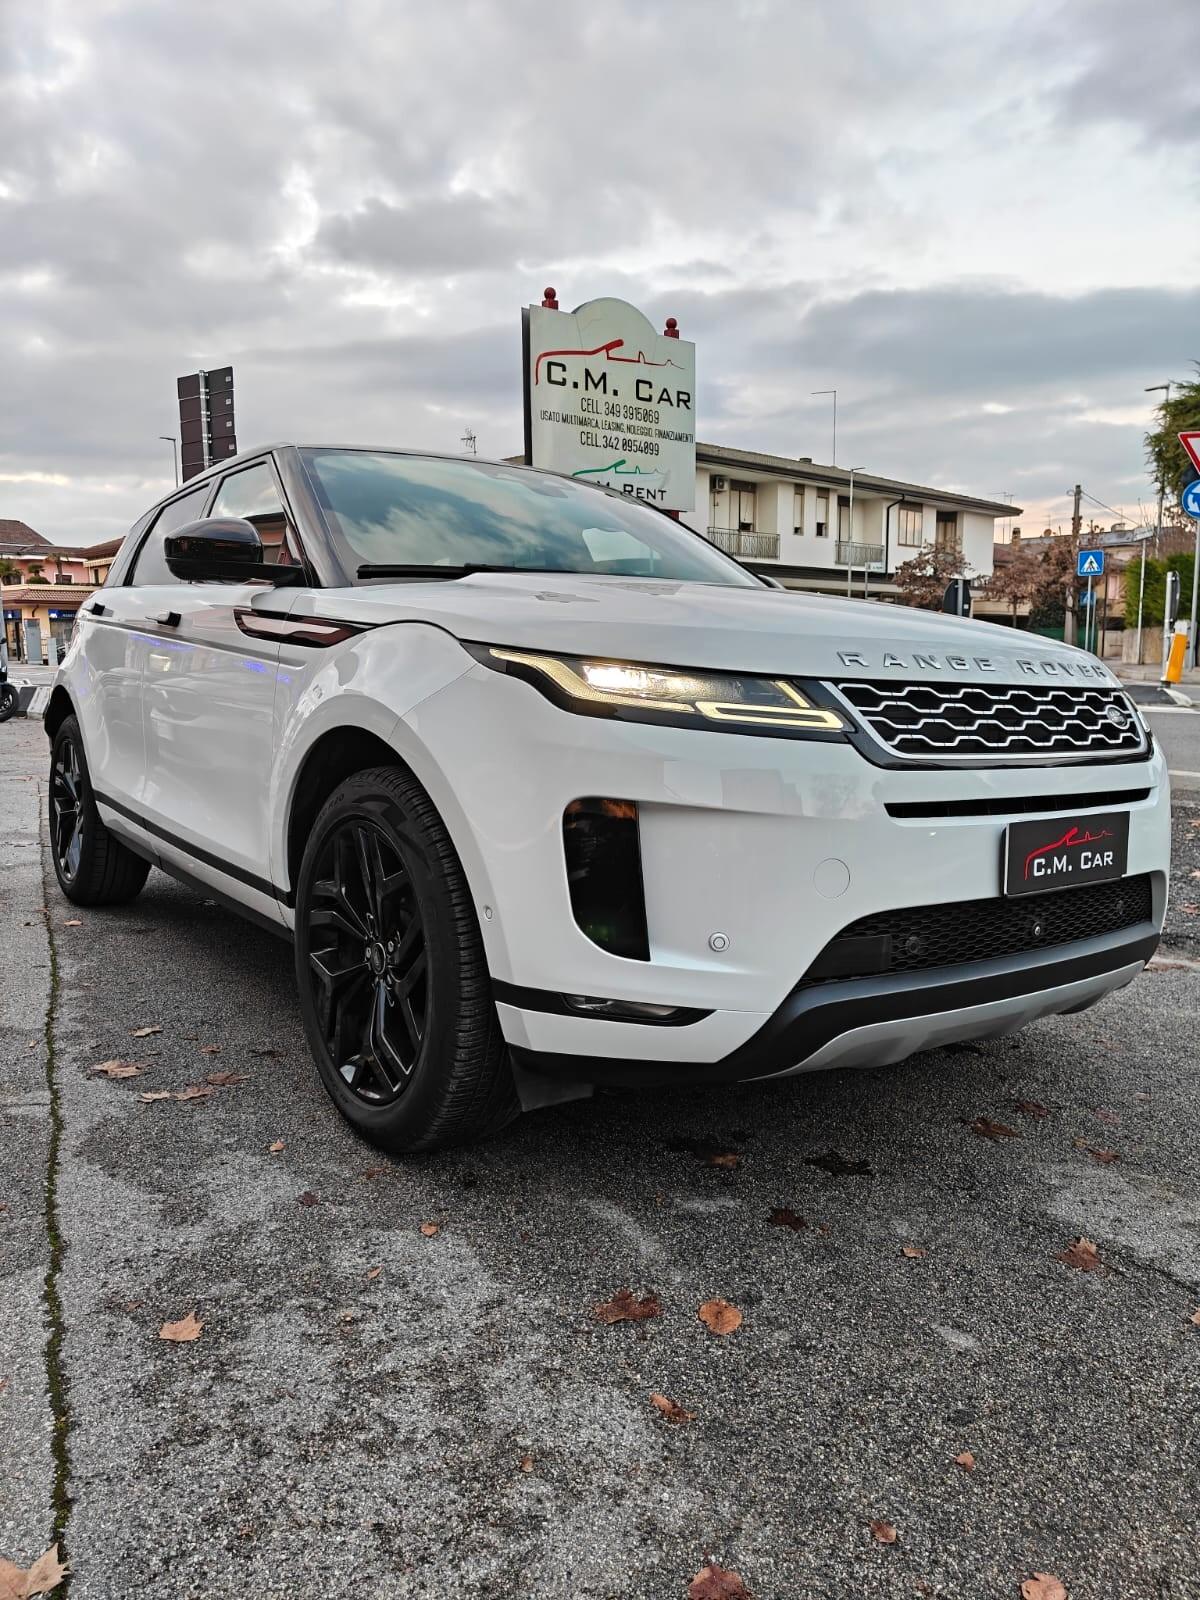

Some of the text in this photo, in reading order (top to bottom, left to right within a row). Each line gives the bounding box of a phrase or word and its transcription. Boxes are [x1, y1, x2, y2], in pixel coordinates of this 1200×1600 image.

[547, 361, 691, 410] C.M. CAR
[604, 401, 621, 418] 349
[622, 404, 660, 425] 3915069
[540, 409, 560, 423] USATO
[654, 428, 694, 444] FINANZIAMENTI
[602, 435, 620, 451] 342
[621, 438, 660, 456] 0954099
[623, 483, 667, 501] RENT
[836, 651, 1107, 678] RANGE ROVER
[1033, 851, 1113, 877] C.M. CAR
